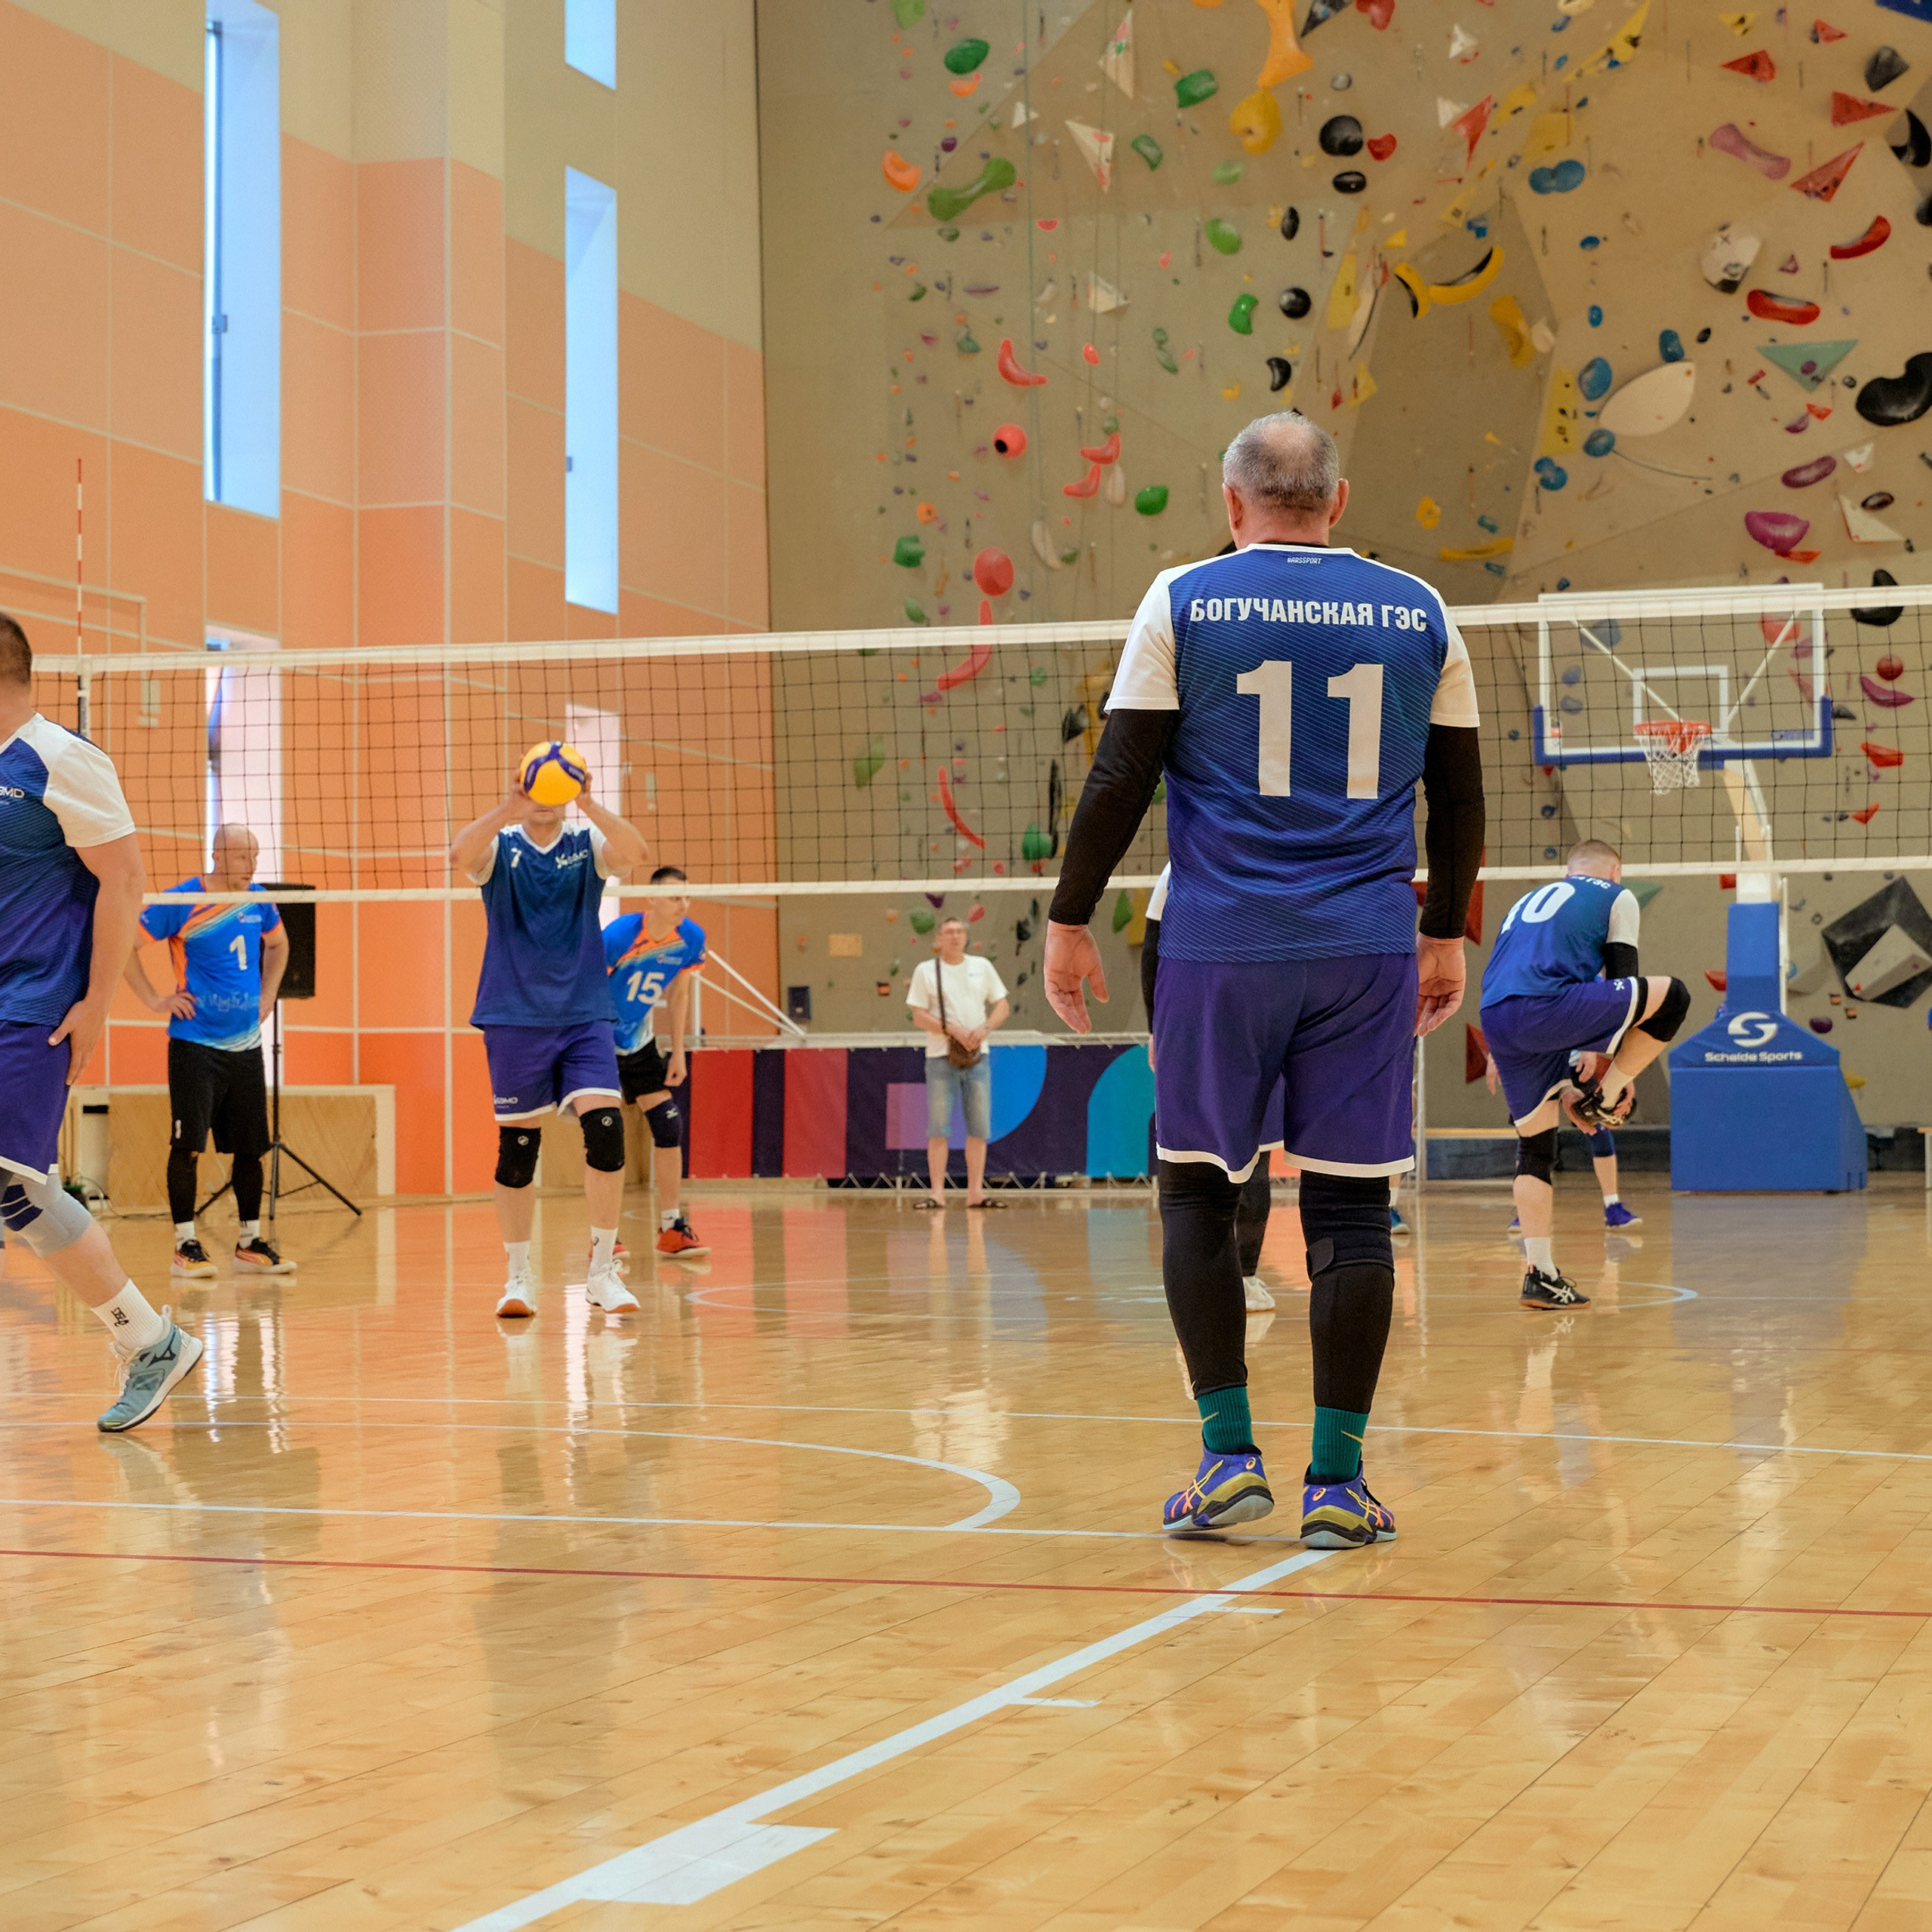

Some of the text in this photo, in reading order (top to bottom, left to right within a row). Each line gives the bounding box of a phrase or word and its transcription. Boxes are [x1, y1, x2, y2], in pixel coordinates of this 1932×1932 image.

[1190, 598, 1427, 632] БОГУЧАНСКАЯ ГЭС
[1236, 660, 1384, 799] 11
[510, 848, 522, 869] 7
[1500, 881, 1576, 934] 10
[229, 934, 248, 971] 1
[626, 971, 665, 1004] 15
[1758, 1051, 1803, 1063] Sports
